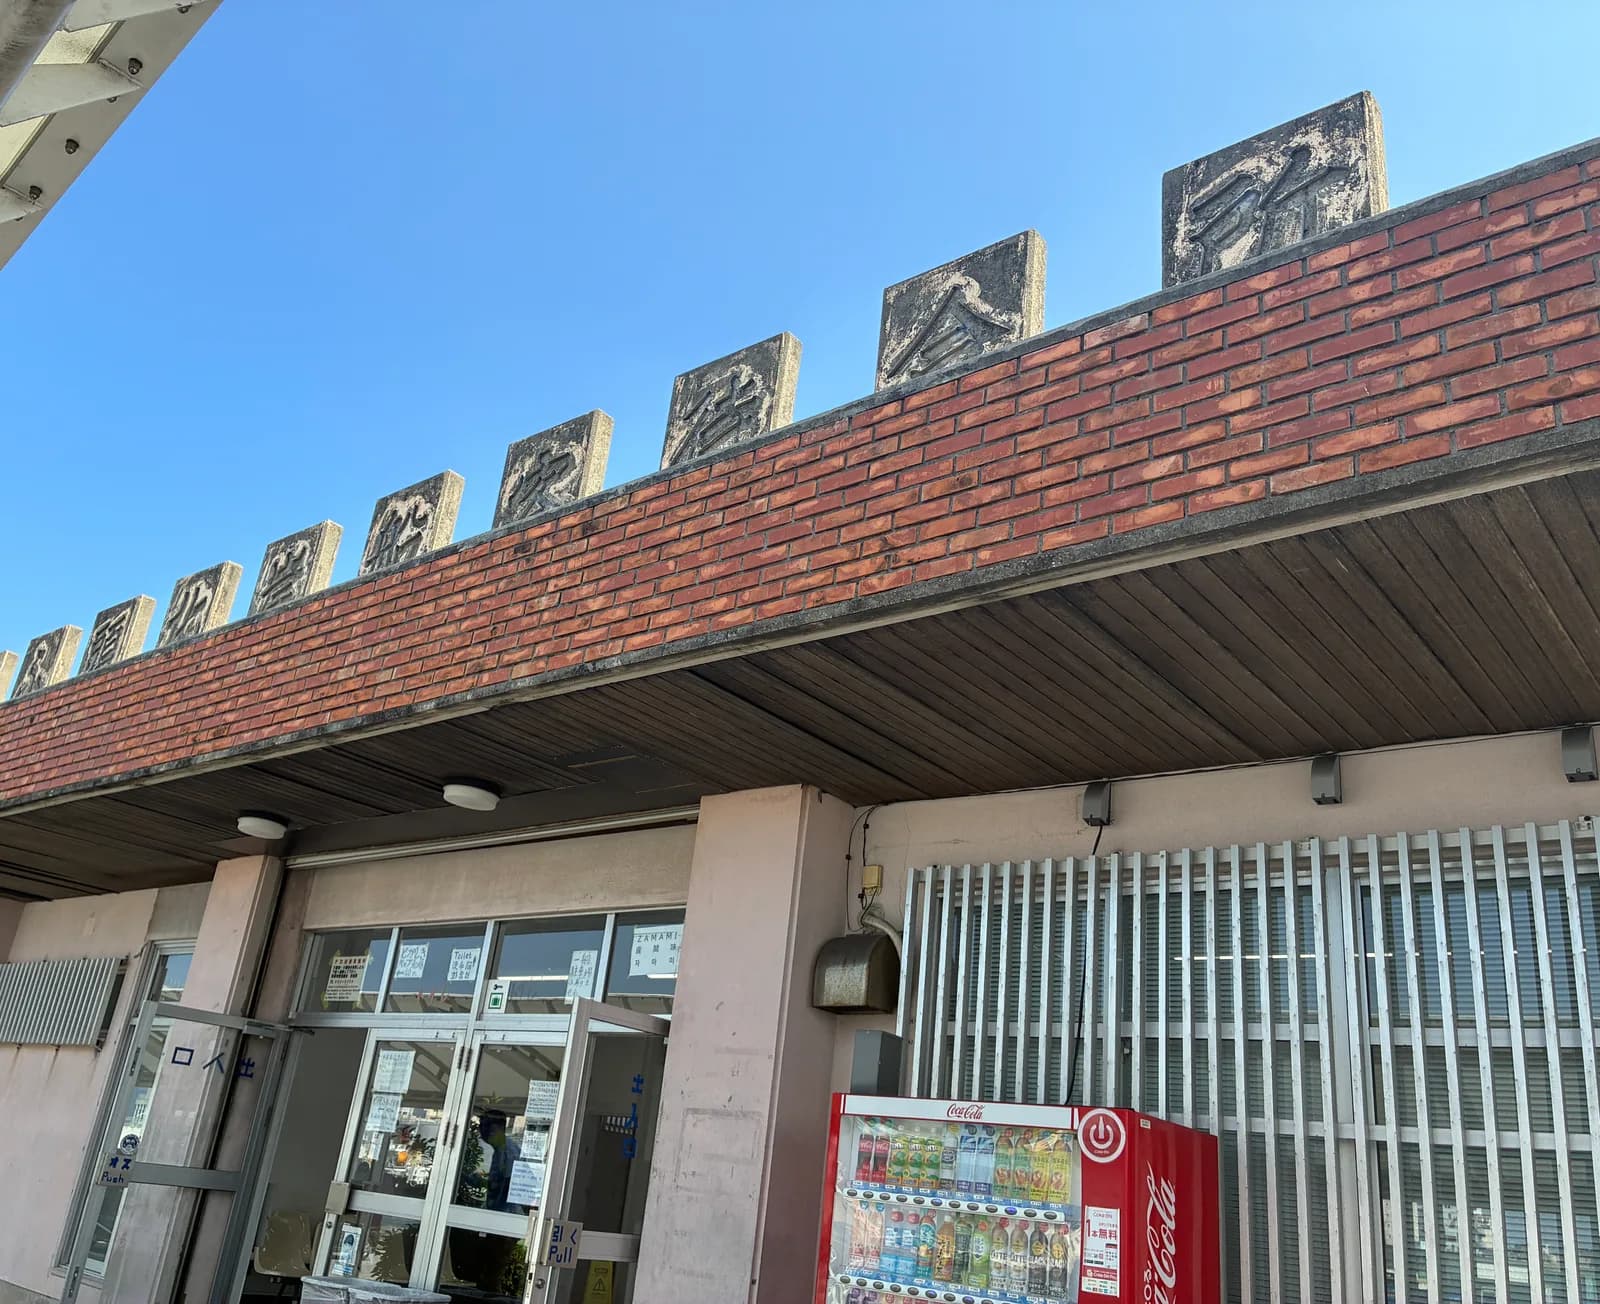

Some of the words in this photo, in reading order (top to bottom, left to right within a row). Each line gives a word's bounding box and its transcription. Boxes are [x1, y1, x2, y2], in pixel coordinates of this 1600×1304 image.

[454, 952, 472, 960] Toilet
[101, 1171, 124, 1183] Push
[552, 1225, 577, 1245] 引く
[547, 1245, 573, 1264] Pull
